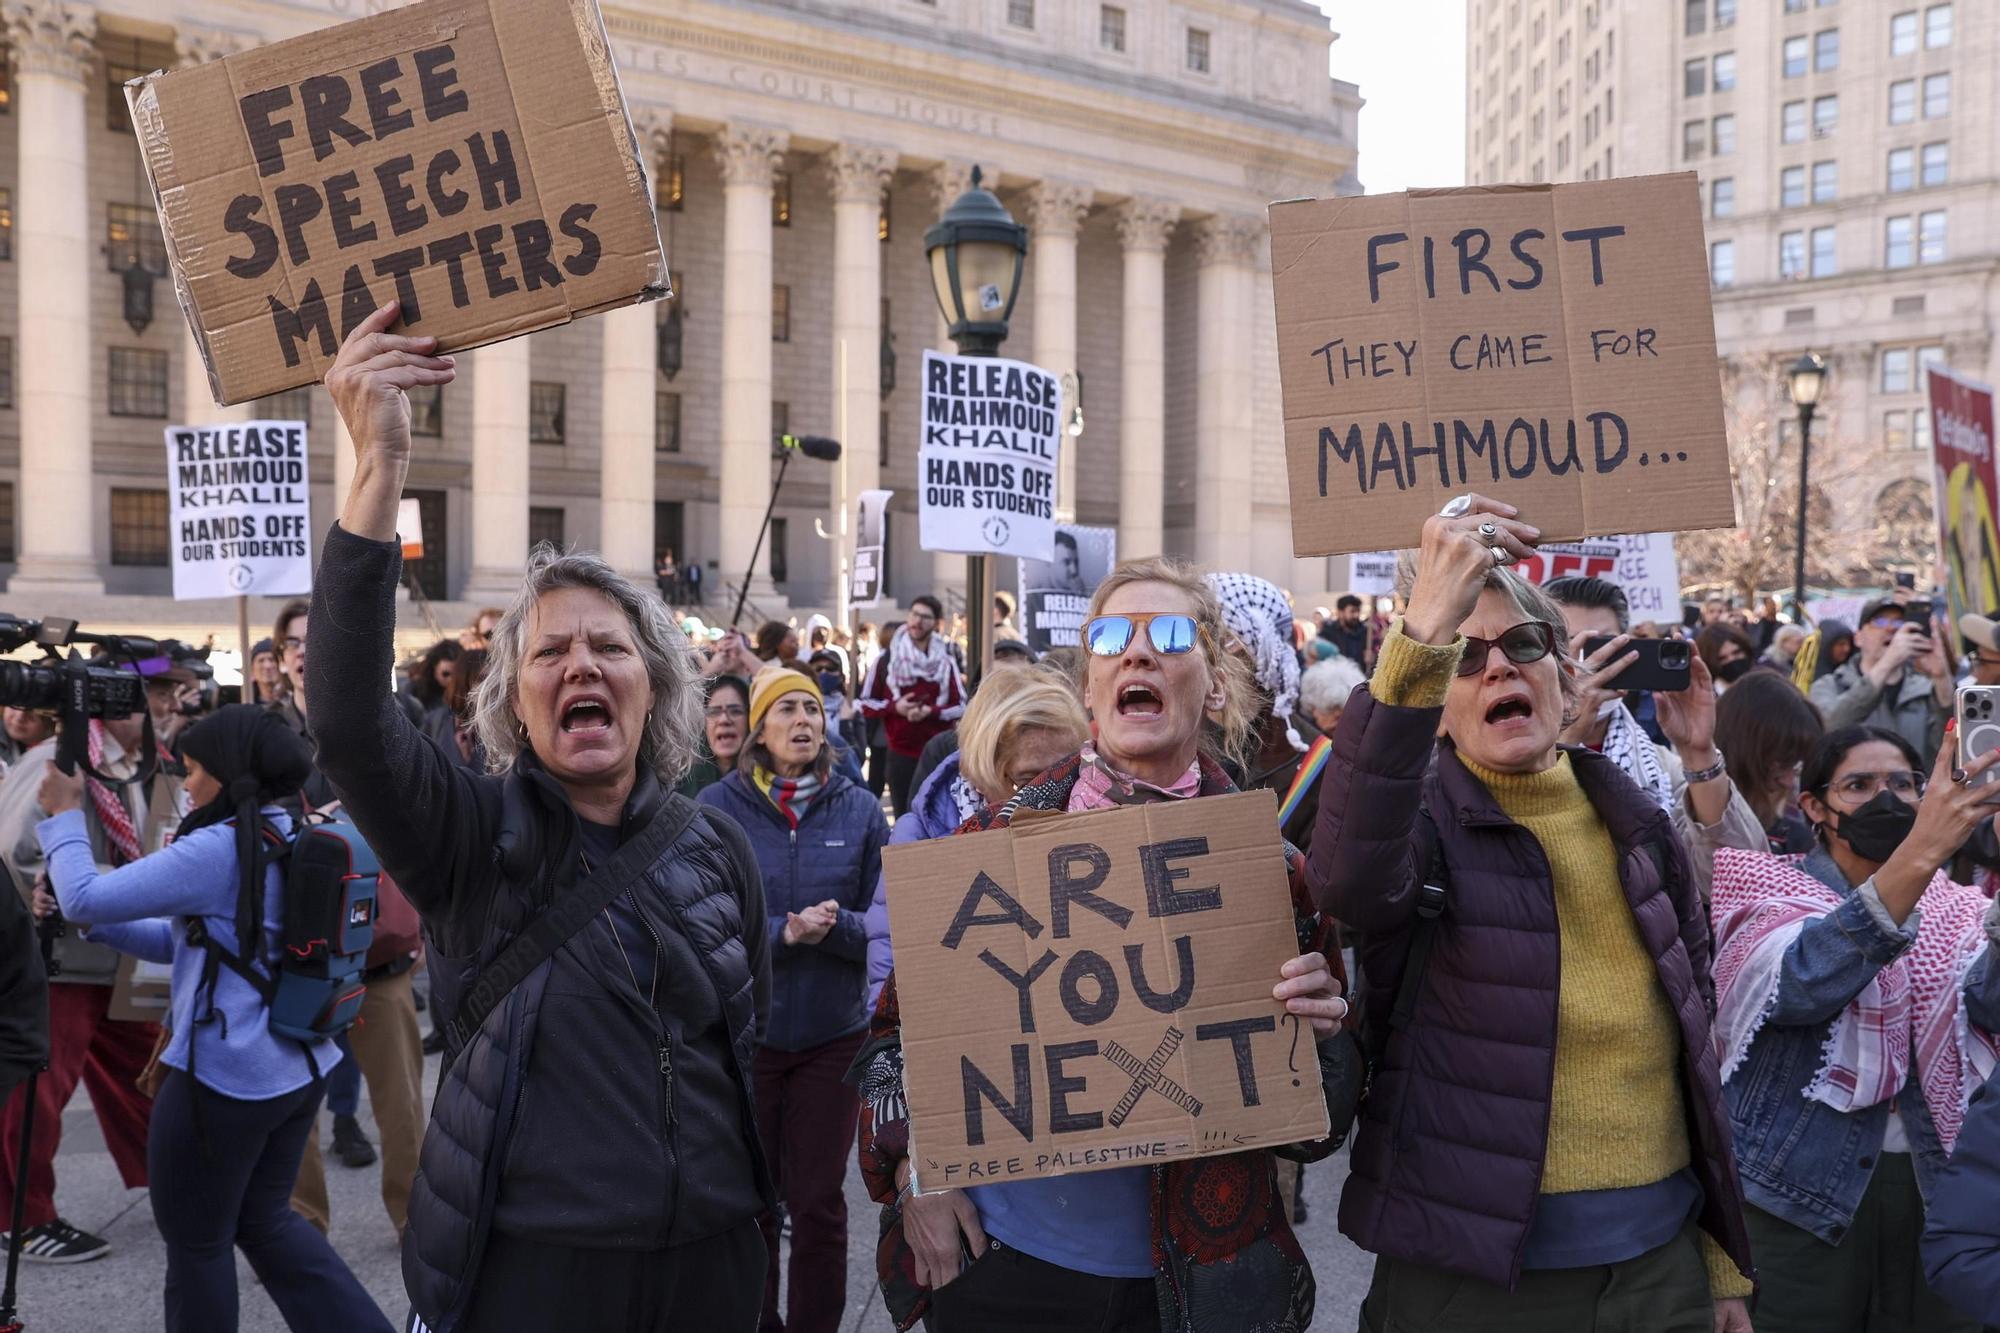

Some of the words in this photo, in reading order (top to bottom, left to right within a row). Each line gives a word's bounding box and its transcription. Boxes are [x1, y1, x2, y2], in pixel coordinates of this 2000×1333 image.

[240, 44, 469, 177] FREE
[729, 64, 859, 109] COURT
[895, 96, 1000, 138] HOUSE
[224, 130, 523, 279] SPEECH
[1367, 226, 1626, 303] FIRST
[268, 203, 602, 368] MATTERS
[1311, 338, 1418, 386] THEY
[1450, 334, 1552, 370] CAME
[1591, 328, 1659, 362] FOR
[928, 359, 1056, 409] RELEASE
[927, 396, 1054, 437] MAHMOUD
[175, 428, 303, 462] RELEASE
[926, 427, 1053, 460] KHALIL
[1317, 411, 1687, 497] MAHMOUD...
[179, 461, 302, 488] MAHMOUD
[927, 458, 1015, 490] HANDS
[1022, 467, 1053, 498] OFF
[181, 487, 304, 508] KHALIL
[926, 487, 966, 508] OUR
[972, 490, 1053, 520] STUDENTS
[182, 516, 256, 543] HANDS
[265, 516, 305, 538] OFF
[182, 544, 215, 562] OUR
[221, 540, 306, 561] STUDENTS
[1043, 593, 1091, 614] RELEAS
[1050, 629, 1082, 647] KHA
[73, 679, 84, 712] SONY
[940, 836, 1223, 950] ARE
[977, 934, 1196, 1034] YOU
[960, 1013, 1301, 1147] NEXT?
[944, 1157, 1025, 1181] FREE
[1034, 1142, 1168, 1170] PALESTINE
